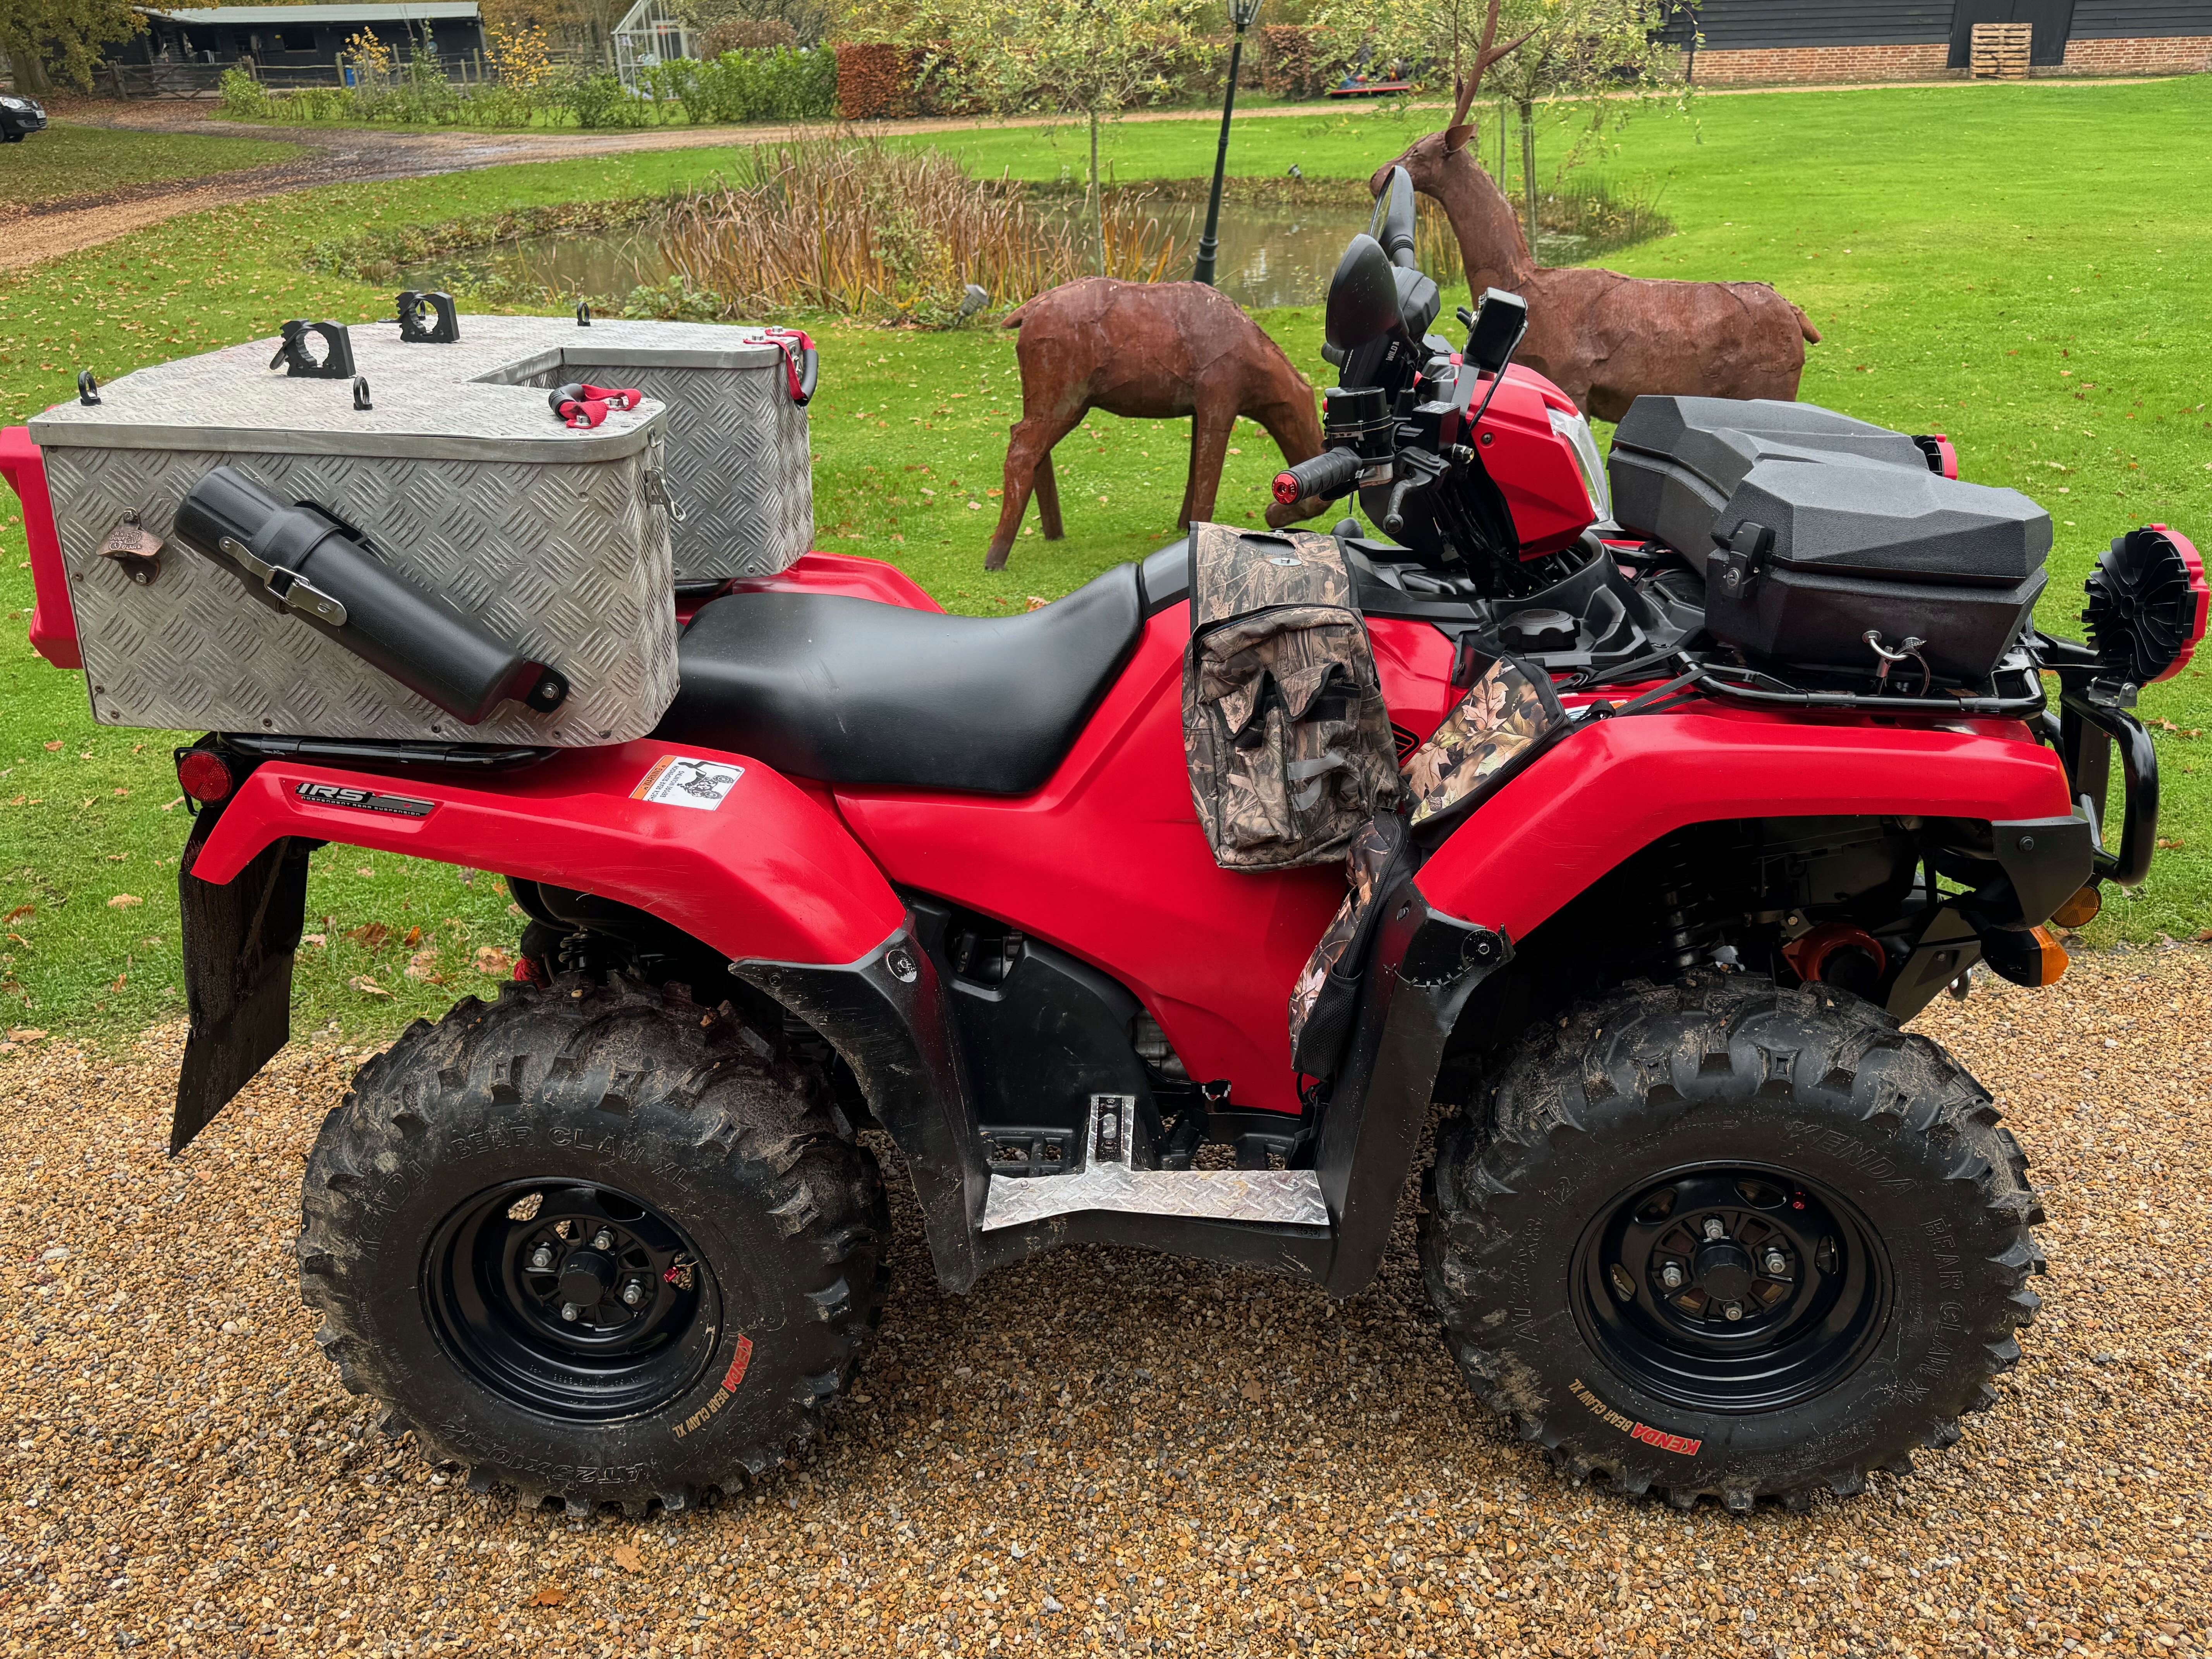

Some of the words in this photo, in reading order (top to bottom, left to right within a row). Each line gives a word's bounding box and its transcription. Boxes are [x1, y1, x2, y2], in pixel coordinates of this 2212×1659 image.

[1386, 345, 1398, 361] WILD
[299, 783, 366, 801] IRS
[301, 796, 350, 806] NDEPENDENT
[374, 807, 420, 816] SUSPENSION
[1779, 1121, 1917, 1198] KENDA
[356, 1159, 433, 1262] KENDA
[451, 1126, 534, 1159] BEAR
[548, 1127, 646, 1164] CLAW
[651, 1156, 689, 1193] XL
[1920, 1218, 1965, 1290] BEAR
[1919, 1302, 1964, 1379] CLAW
[721, 1333, 754, 1393] KENDA
[1568, 1378, 1585, 1394] XL
[1886, 1378, 1930, 1408] XL
[706, 1387, 730, 1413] BEAR
[1577, 1390, 1608, 1415] CLAW
[672, 1423, 687, 1438] XL
[685, 1407, 711, 1432] CLAW
[1603, 1409, 1634, 1432] BEAR
[1630, 1421, 1702, 1456] KENDA
